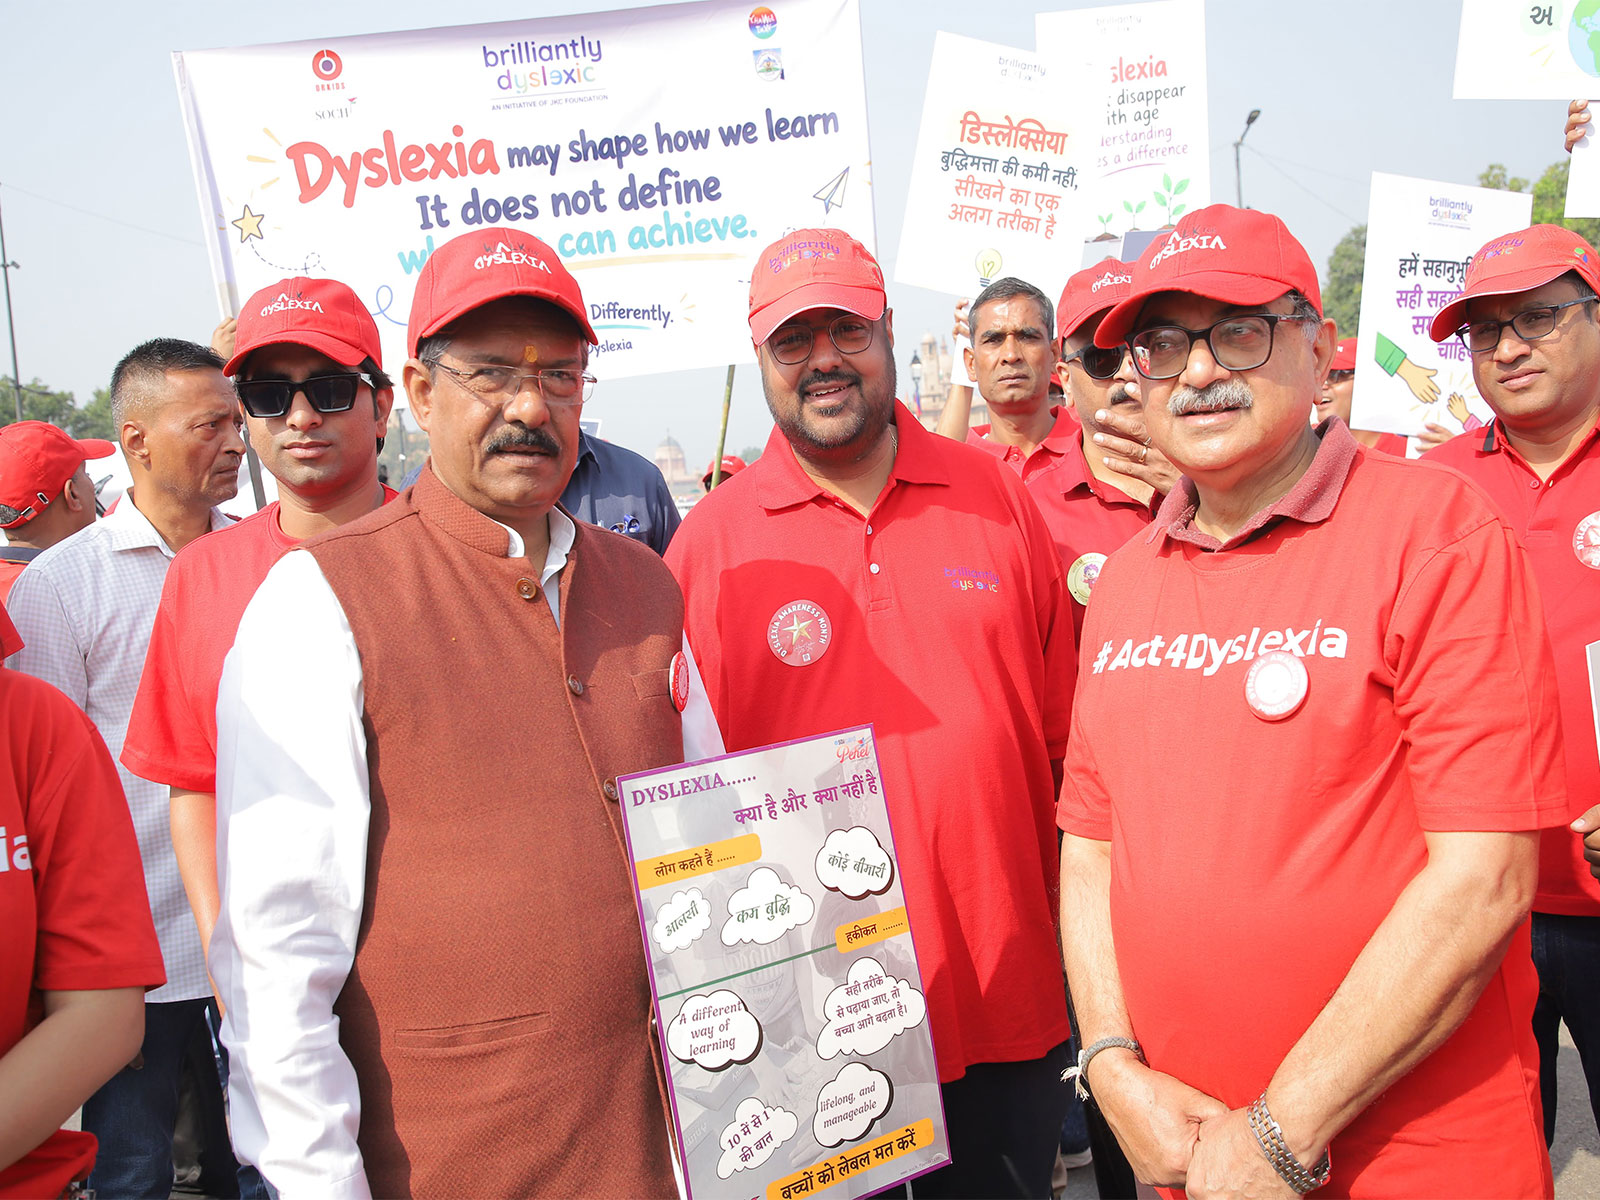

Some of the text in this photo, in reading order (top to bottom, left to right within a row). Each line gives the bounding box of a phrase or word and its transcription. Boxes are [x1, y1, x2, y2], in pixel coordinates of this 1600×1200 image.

[1530, 6, 1553, 26] અ
[482, 36, 602, 68] brilliantly
[503, 101, 537, 110] INITIATIVE
[565, 94, 609, 104] FOUNDATION
[1117, 85, 1186, 107] disappear
[1107, 108, 1159, 127] ith age
[960, 110, 1068, 155] डिस्लेक्सिया
[286, 108, 839, 208] Dyslexia may shape how we learn
[1114, 154, 1121, 164] a
[1127, 143, 1188, 162] difference
[941, 147, 1079, 191] बुद्धिमत्ता की कमी नहीं,
[416, 167, 722, 230] It does not define
[955, 174, 1062, 213] सीखने का एक
[1429, 196, 1473, 214] brilliantly
[558, 210, 758, 258] can achieve.
[948, 202, 1057, 240] अलग तरीका है
[474, 252, 552, 274] DYSLEXIA
[769, 241, 840, 269] brilliantly
[1149, 235, 1227, 270] DYSLEXIA
[1398, 252, 1420, 279] हमें
[1091, 274, 1132, 293] DYSLEXI
[1396, 283, 1423, 310] सही
[260, 299, 324, 317] DYSLEXIA
[590, 301, 674, 329] Differently.
[944, 566, 999, 584] brilliantly
[771, 603, 828, 657] DYSLEXIA AWARENESS MONTH
[1092, 618, 1348, 676] #Act4Dyslexia
[733, 769, 877, 824] क्या है और क्या नहीं है
[654, 862, 676, 878] लोग
[678, 853, 703, 871] कहते
[828, 851, 887, 879] कोई बीमारी
[665, 900, 699, 937] आलसी
[736, 905, 760, 924] कम
[845, 923, 877, 943] हकीकत
[845, 974, 883, 996] सही तरीके
[680, 1001, 742, 1025] A different
[836, 1005, 845, 1018] से
[890, 985, 901, 998] तो
[691, 1018, 730, 1039] way of
[857, 1014, 874, 1030] आगे
[690, 1038, 736, 1057] learning
[820, 1081, 876, 1112] lifelong, and
[824, 1100, 877, 1128] manageable
[727, 1110, 770, 1150] 10 में से 1
[739, 1130, 774, 1163] की बात
[780, 1128, 917, 1200] बच्चों को लेबल मत करें
